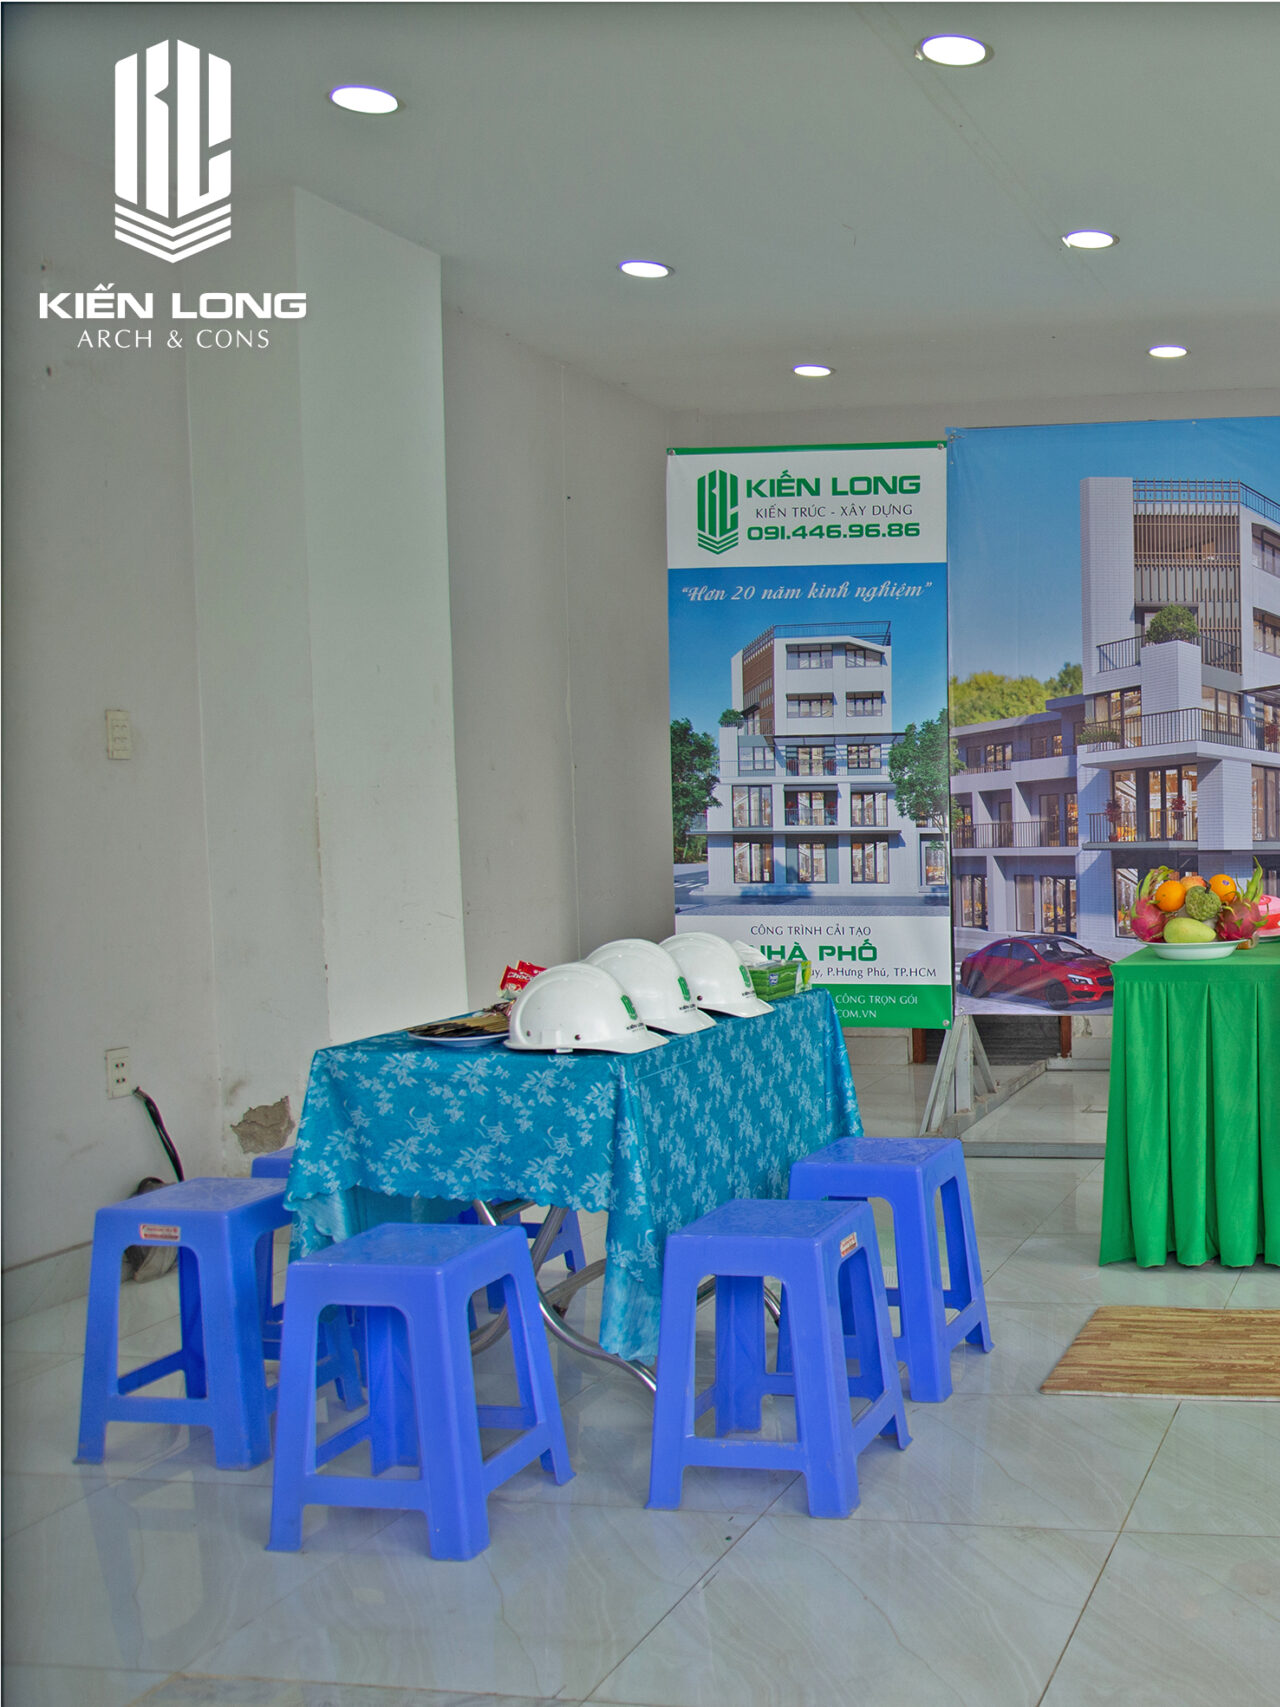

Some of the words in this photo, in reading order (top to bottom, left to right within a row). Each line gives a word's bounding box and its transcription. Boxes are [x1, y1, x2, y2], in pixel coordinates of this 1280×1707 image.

[746, 470, 821, 498] KIẾN
[831, 475, 921, 496] LONG
[756, 504, 787, 519] KIẾN
[792, 503, 826, 518] TRÚC
[840, 503, 867, 517] XÂY
[872, 503, 913, 518] DỰNG
[747, 522, 921, 541] 091.446.96.86
[731, 585, 756, 600] 20
[761, 585, 802, 600] năm
[807, 581, 850, 599] kinh
[750, 924, 784, 936] CÔNG
[788, 924, 822, 936] TRÌNH
[826, 923, 845, 936] CẢI
[849, 925, 872, 937] TẠO
[818, 939, 878, 962] PHỐ
[827, 967, 863, 980] P.Hưng
[867, 967, 889, 978] Phú,
[894, 967, 937, 977] TP.HCM
[835, 992, 866, 1004] CÔNG
[869, 994, 896, 1006] TRỌN
[899, 993, 918, 1005] GÓI
